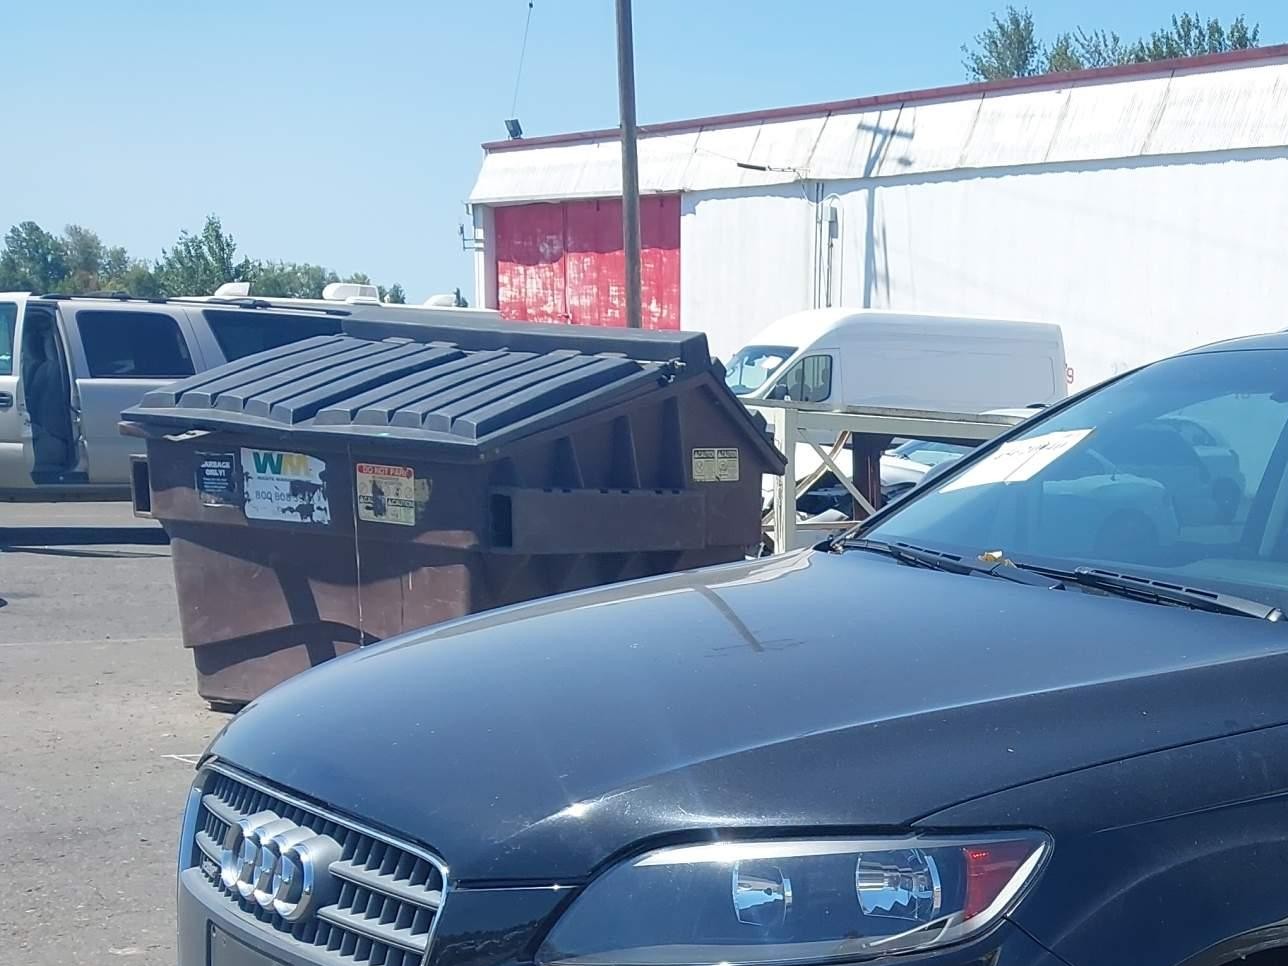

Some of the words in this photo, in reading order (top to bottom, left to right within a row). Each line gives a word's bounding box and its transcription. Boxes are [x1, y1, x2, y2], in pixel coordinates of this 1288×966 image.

[253, 451, 310, 476] WM
[362, 465, 374, 473] DO
[374, 467, 388, 475] NOT
